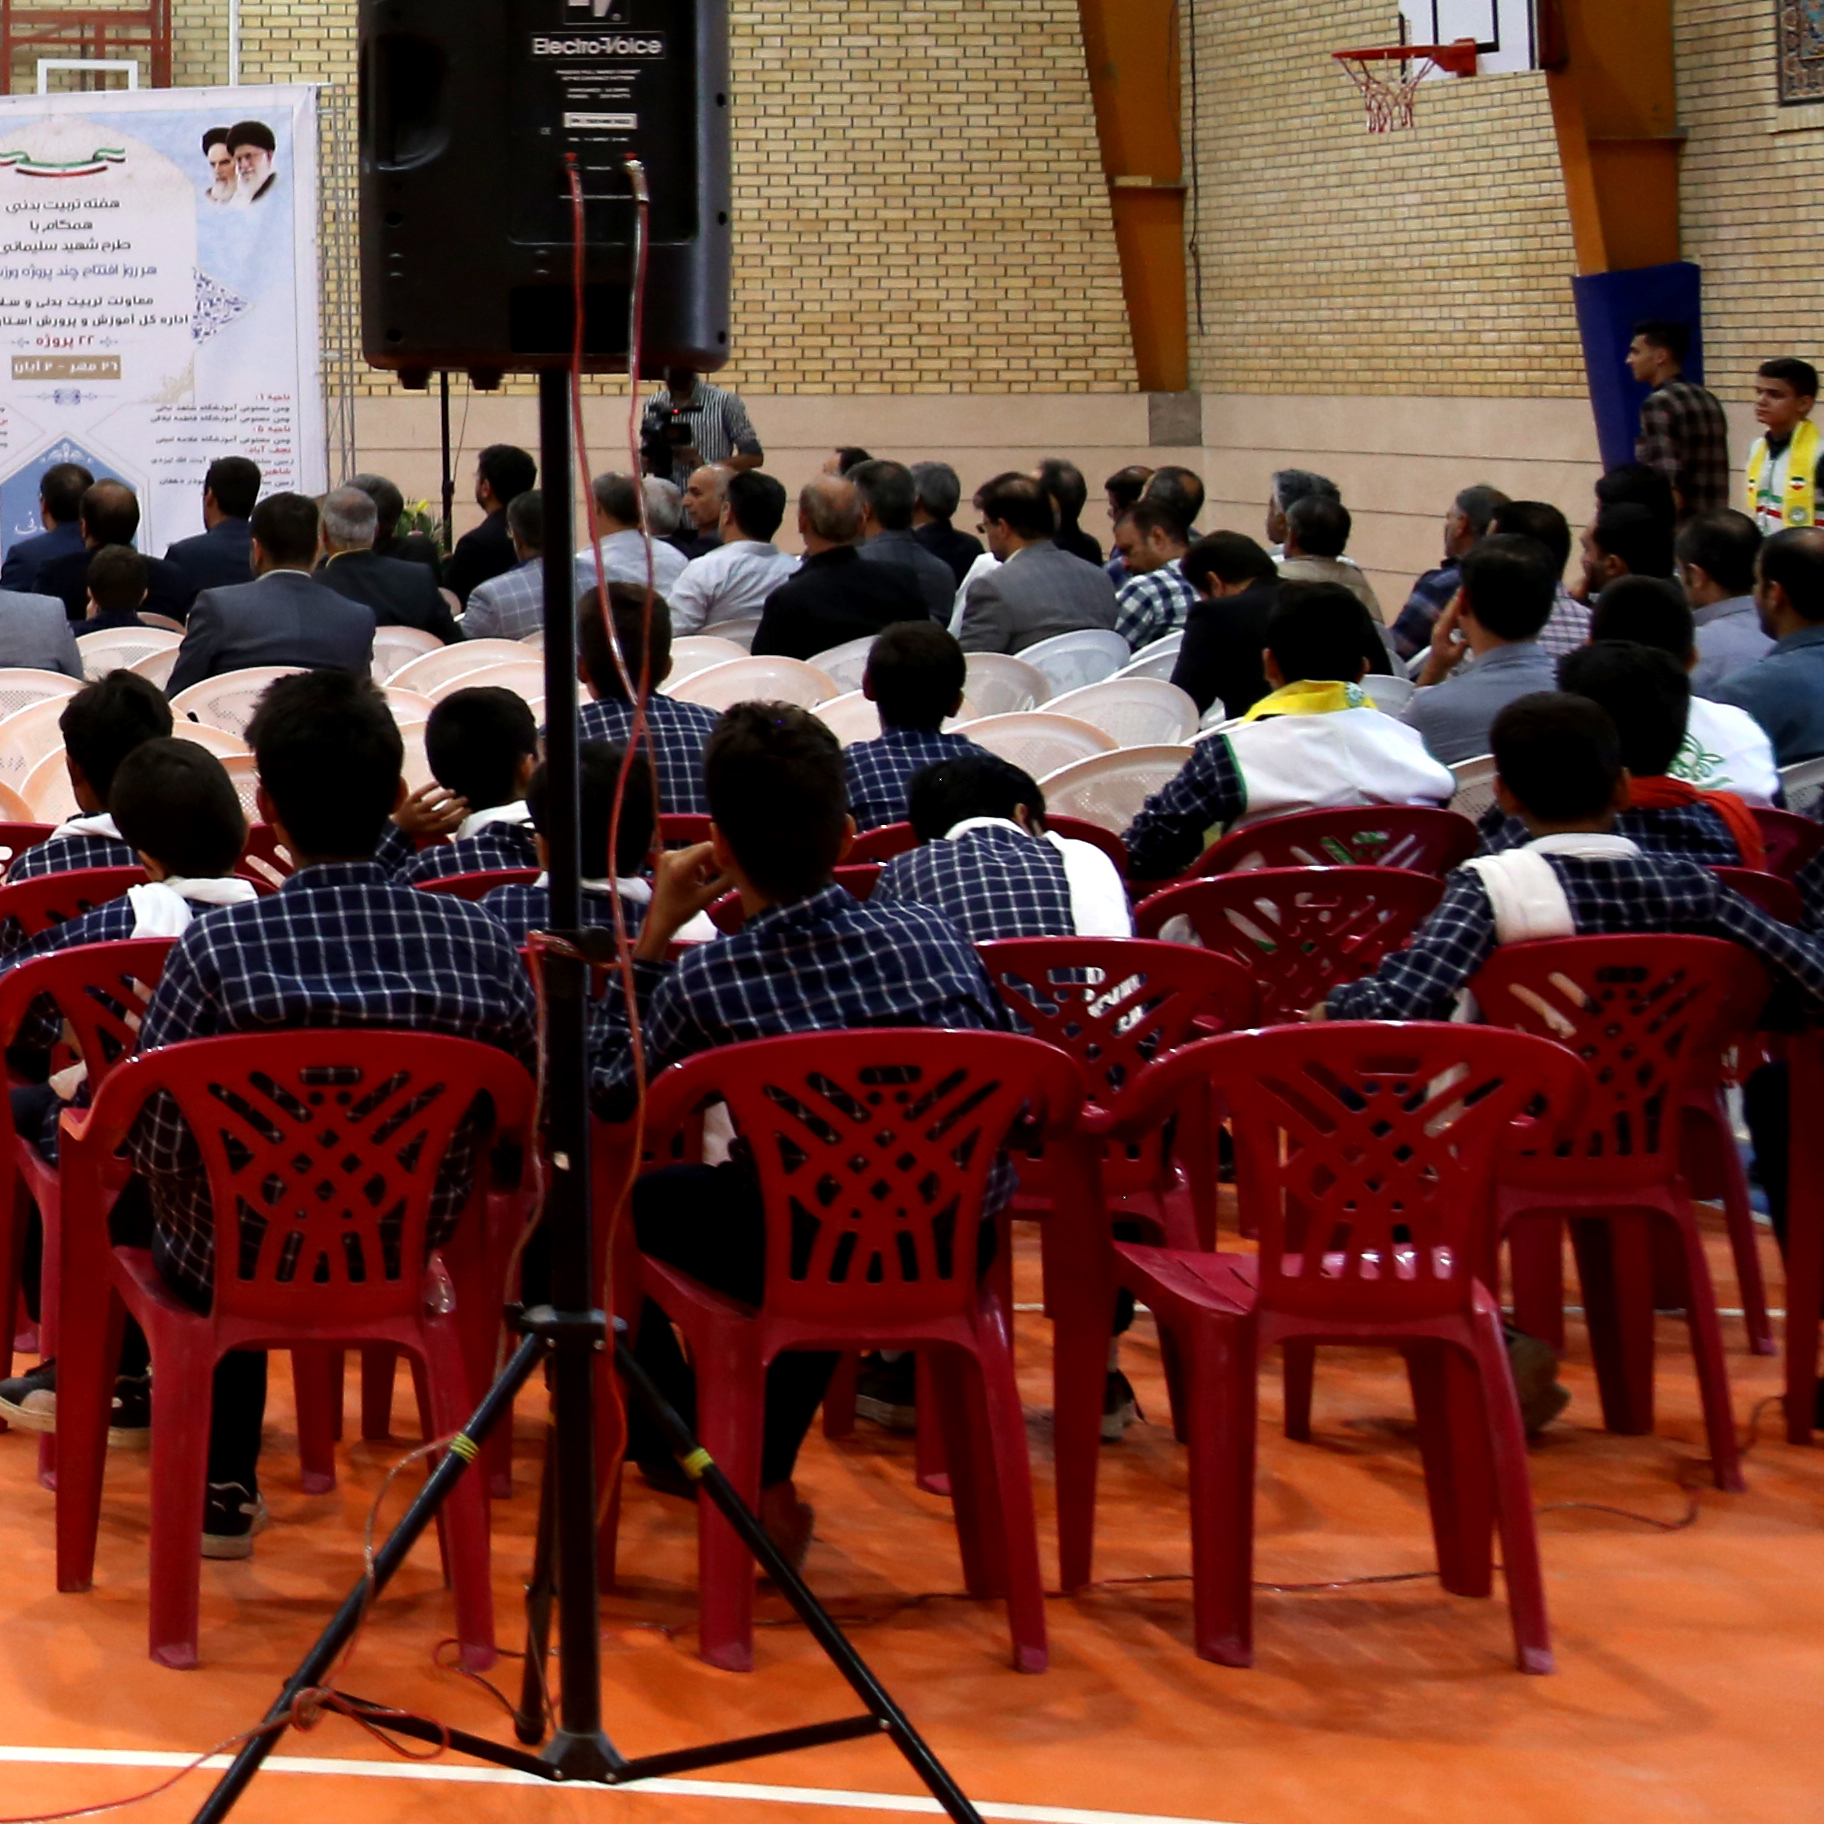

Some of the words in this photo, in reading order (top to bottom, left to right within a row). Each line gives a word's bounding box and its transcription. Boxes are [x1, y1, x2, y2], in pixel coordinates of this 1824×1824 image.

[532, 37, 663, 55] Electro-Voice
[5, 200, 41, 214] بدنی
[84, 198, 121, 210] هفته
[30, 219, 40, 232] با
[61, 236, 99, 253] شهید
[101, 237, 132, 253] طرح
[36, 296, 62, 309] بدنی
[67, 296, 102, 309] تربیت
[108, 296, 154, 308] معاونت
[37, 315, 77, 328] پرورش
[92, 312, 135, 327] آموزش
[139, 313, 157, 327] کل
[160, 313, 189, 326] اداره
[36, 334, 75, 349] پروژه
[13, 360, 42, 374] آبان
[69, 361, 98, 374] مهر
